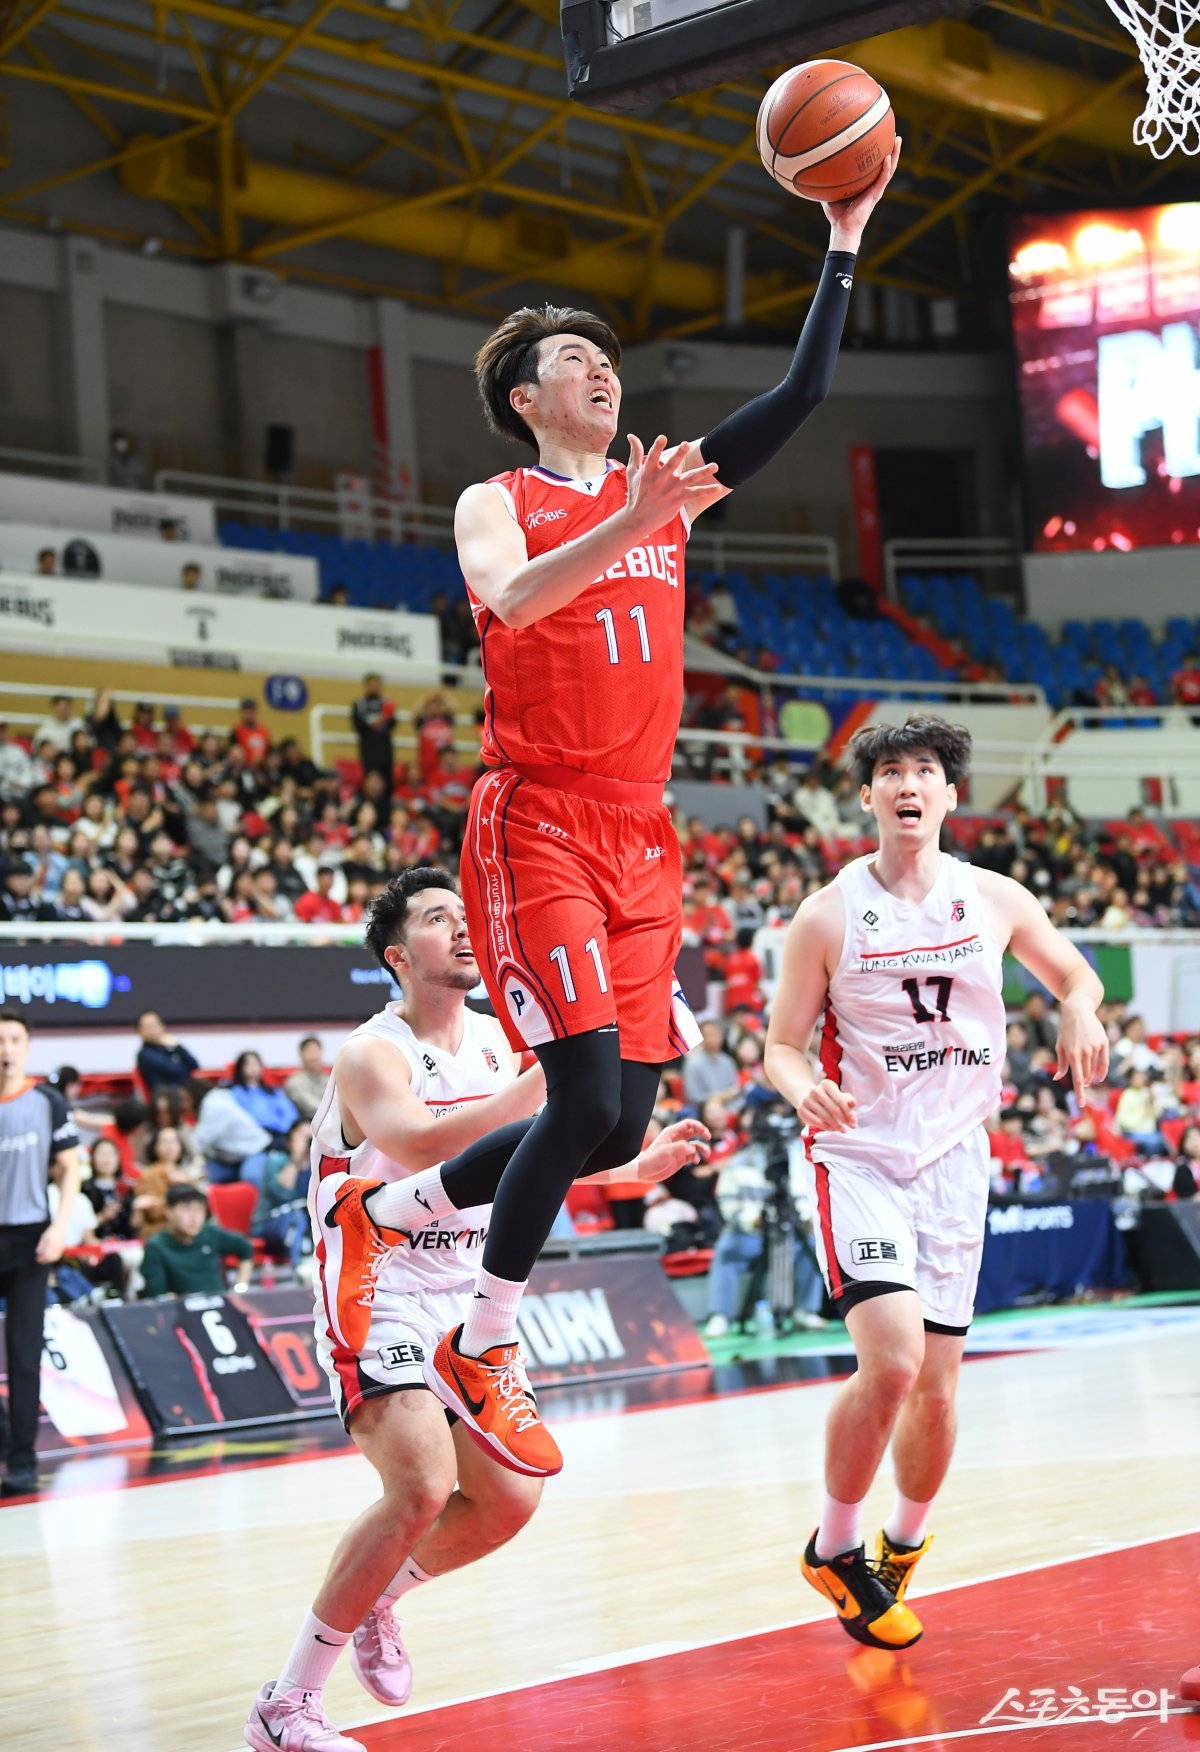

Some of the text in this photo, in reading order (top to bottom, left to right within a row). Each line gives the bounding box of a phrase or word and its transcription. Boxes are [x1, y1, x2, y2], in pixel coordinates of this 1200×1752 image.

[592, 544, 678, 588] EBUS
[595, 604, 652, 664] 11
[494, 921, 506, 952] MOBIS
[549, 937, 609, 1004] 11
[509, 989, 526, 1017] P
[902, 975, 954, 1024] 17
[885, 1047, 948, 1073] EVERY
[398, 1230, 463, 1251] VERY
[202, 1310, 237, 1355] 6
